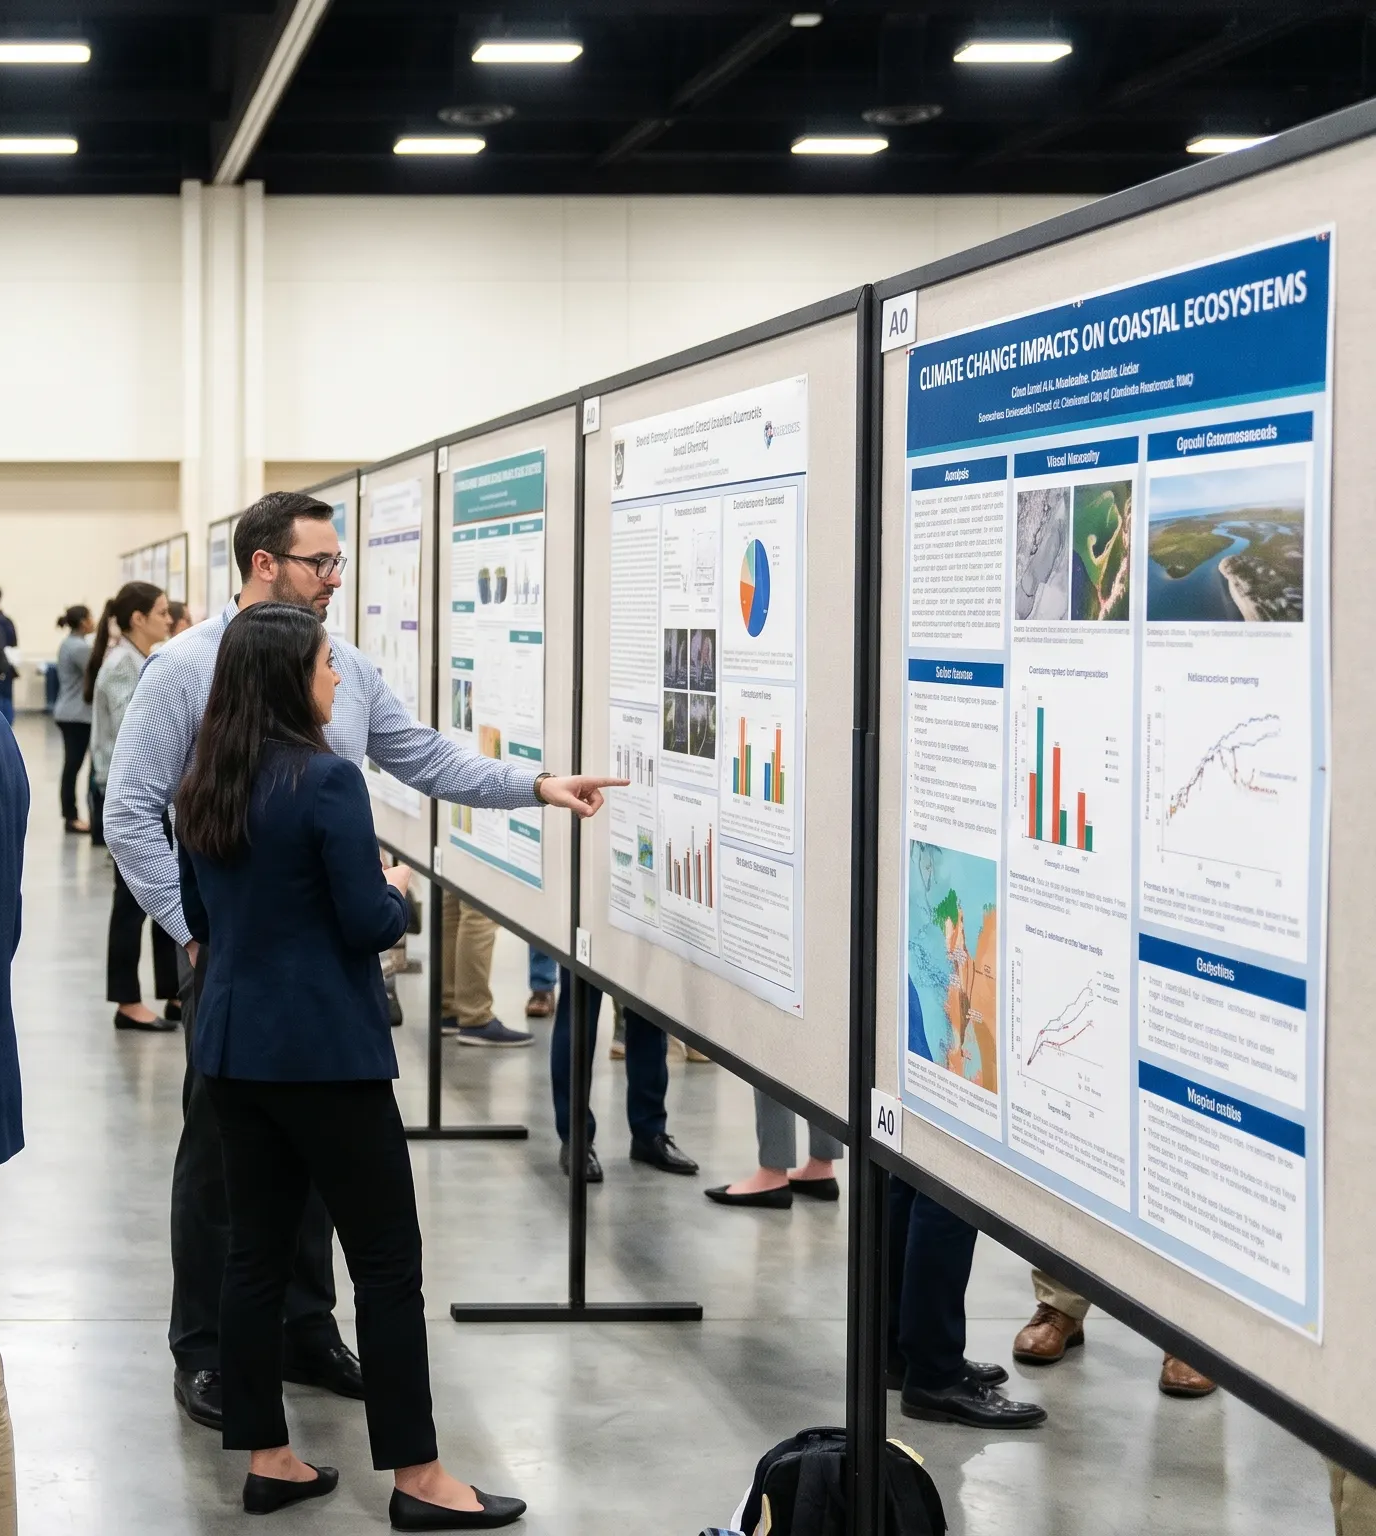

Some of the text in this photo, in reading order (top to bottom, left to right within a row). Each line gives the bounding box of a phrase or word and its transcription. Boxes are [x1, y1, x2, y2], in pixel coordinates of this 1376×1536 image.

[889, 308, 908, 337] A0
[920, 270, 1308, 391] CLIMATE CHANGE IMPACTS ON COASTAL ECOSYSTEMS
[878, 1105, 894, 1136] A0
